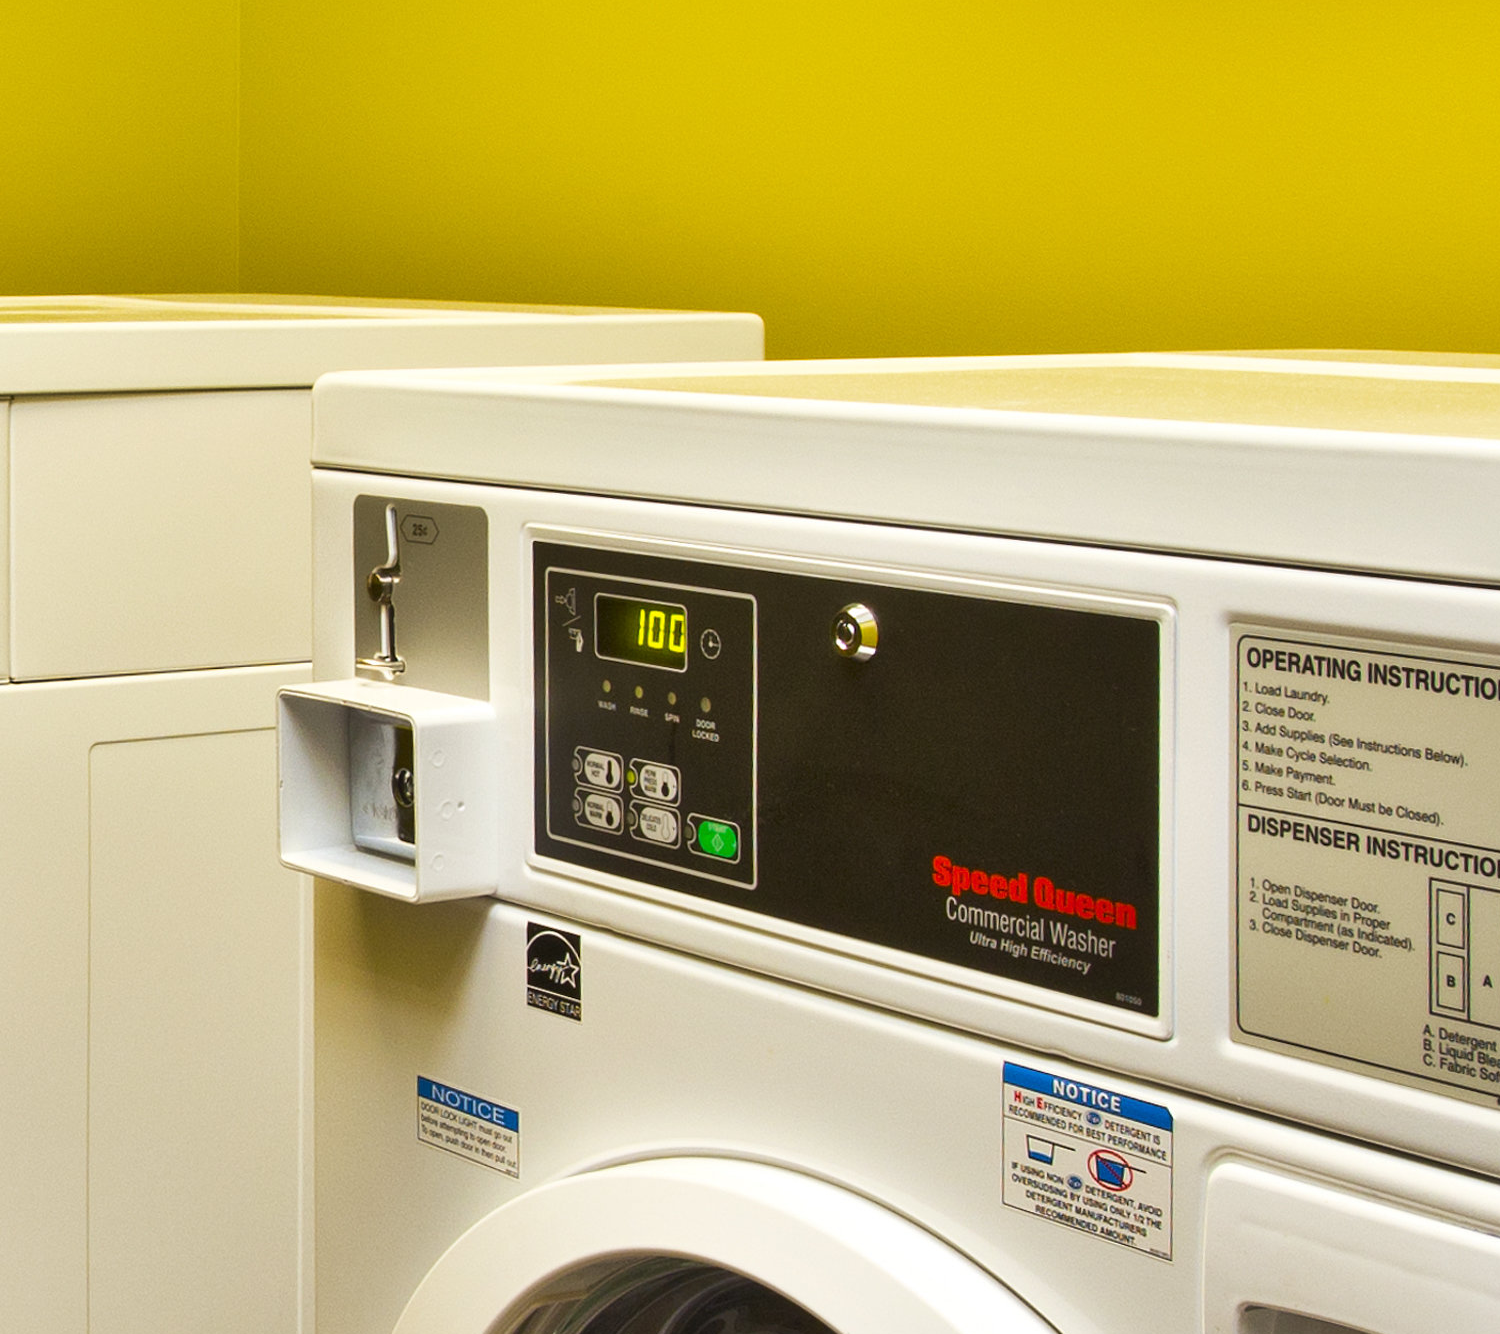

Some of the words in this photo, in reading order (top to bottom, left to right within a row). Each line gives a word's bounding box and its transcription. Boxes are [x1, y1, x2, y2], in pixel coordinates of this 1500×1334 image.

[638, 608, 685, 653] 100
[1246, 647, 1362, 682] OPERATING
[1243, 681, 1252, 693] 1.
[1255, 682, 1282, 697] Load
[1284, 686, 1330, 706] Laundry.
[664, 712, 681, 724] SPIN
[695, 718, 715, 730] DOOR
[1242, 700, 1252, 712] 2.
[1254, 701, 1286, 718] Close
[1287, 706, 1315, 722] Door.
[691, 730, 720, 743] LOCKED
[1242, 720, 1251, 732] 3.
[1254, 722, 1277, 736] Add
[1279, 725, 1326, 744] Supplies
[1328, 733, 1354, 749] (See
[1356, 738, 1422, 759] Instructions
[1424, 747, 1468, 767] Below).
[1242, 740, 1252, 752] 4.
[1255, 741, 1284, 757] Make
[1286, 746, 1316, 763] Cycle
[1319, 751, 1371, 771] Selection.
[1242, 759, 1252, 771] 5.
[1255, 761, 1284, 777] Make
[1286, 766, 1336, 786] Payment.
[1241, 779, 1252, 791] 6.
[1254, 781, 1284, 797] Press
[1286, 786, 1312, 802] Start
[1314, 791, 1346, 807] (Door
[1348, 797, 1376, 813] Must
[1378, 802, 1393, 817] be
[1395, 805, 1444, 826] Closed).
[1248, 813, 1360, 853] DISPENSER
[932, 854, 1029, 904] Speed
[1033, 875, 1138, 930] Queen
[1250, 877, 1259, 889] 1.
[1262, 879, 1291, 895] Open
[1294, 885, 1348, 907] Dispenser
[1351, 897, 1380, 914] Door.
[946, 896, 1045, 942] Commercial
[1049, 920, 1117, 959] Washer
[1249, 890, 1259, 903] 2.
[1262, 893, 1289, 909] Load
[1291, 899, 1338, 920] Supplies
[1340, 909, 1351, 922] in
[1353, 911, 1391, 931] Proper
[1446, 912, 1456, 926] C
[1249, 918, 1259, 931] 3.
[1262, 921, 1293, 939] Close
[1295, 928, 1350, 951] Dispenser
[1352, 940, 1382, 958] Door.
[1262, 907, 1334, 934] Compartment
[1337, 923, 1355, 938] (as
[1357, 927, 1415, 952] Indicated).
[969, 930, 998, 950] Ultra
[1000, 938, 1028, 959] High
[1031, 946, 1092, 975] Efficiency
[1446, 974, 1456, 988] B
[1482, 975, 1493, 988] A
[528, 990, 559, 1011] ENERGY
[1422, 1024, 1435, 1040] A.
[1438, 1027, 1497, 1053] Detergent
[1423, 1038, 1435, 1055] B.
[1438, 1042, 1475, 1062] Liquid
[1422, 1053, 1436, 1068] C.
[1439, 1057, 1477, 1078] Fabric
[432, 1085, 505, 1125] NOTICE
[1053, 1079, 1121, 1112] NOTICE
[1008, 1104, 1067, 1130] RECOMMENDED
[1068, 1122, 1084, 1134] FOR
[1086, 1127, 1106, 1141] BEST
[1107, 1133, 1167, 1161] PERFORMANCE
[1036, 1097, 1082, 1121] EFFICIENCY
[1104, 1119, 1152, 1142] DETERGENT
[1152, 1135, 1161, 1146] IS
